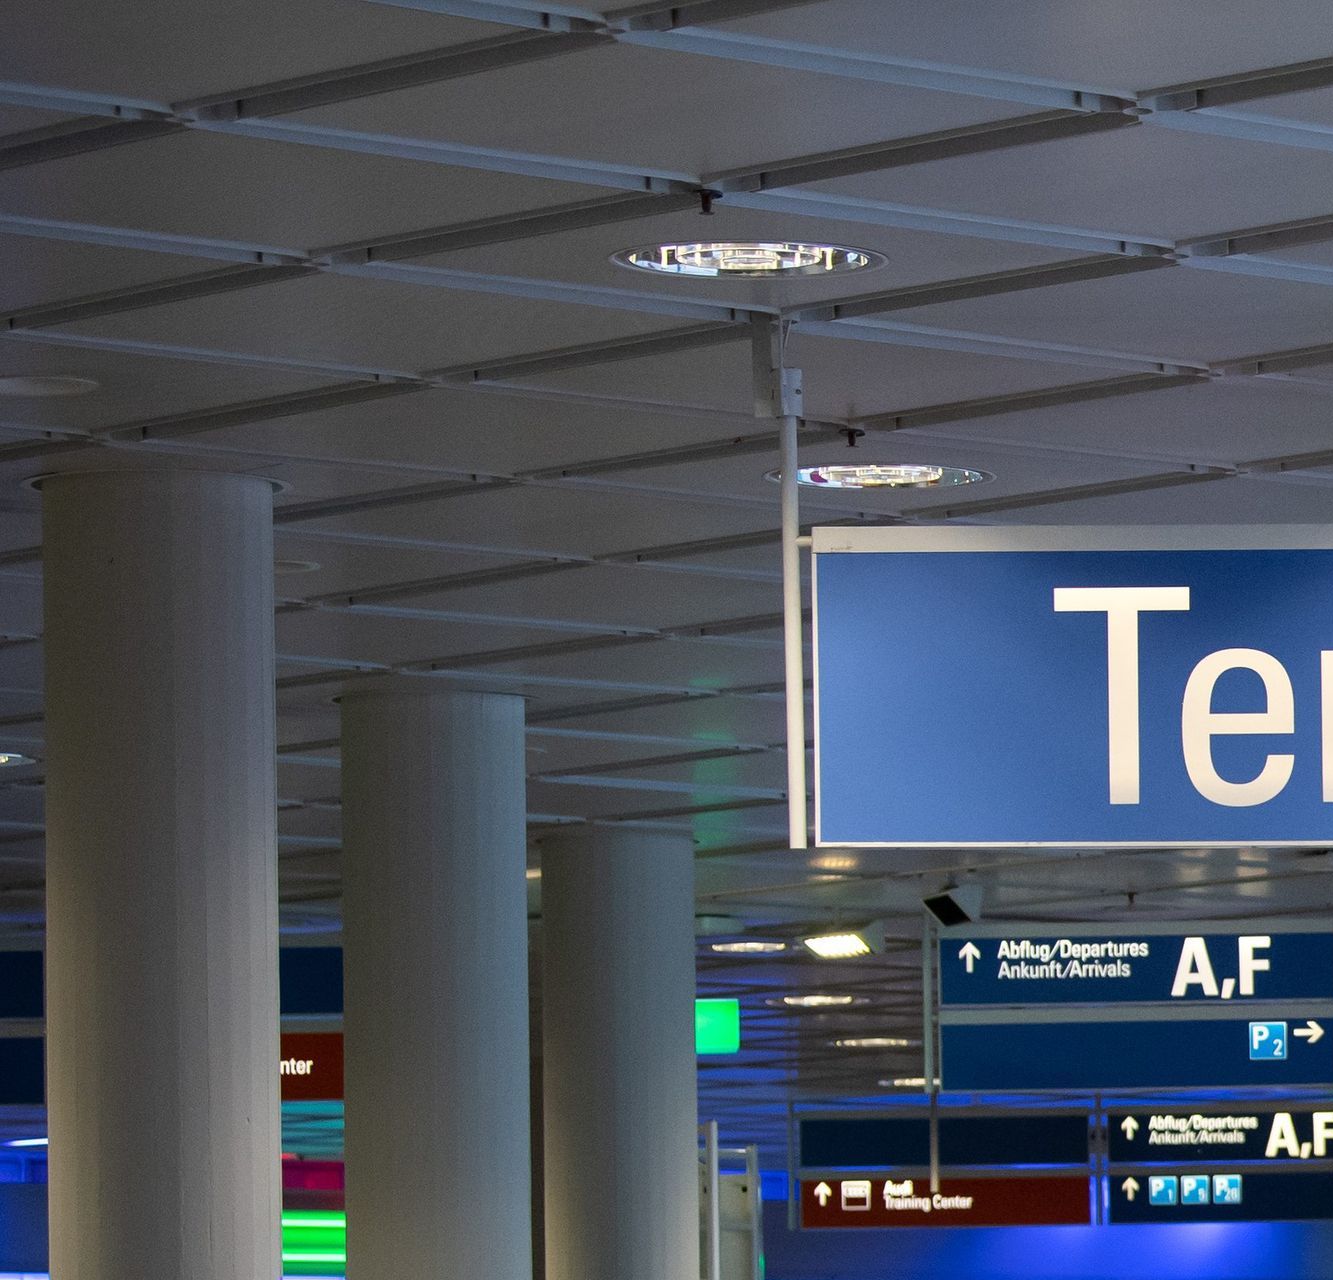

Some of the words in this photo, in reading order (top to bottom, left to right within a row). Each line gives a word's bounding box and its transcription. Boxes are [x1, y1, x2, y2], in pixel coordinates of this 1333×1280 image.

[997, 939, 1149, 960] Abflug/Departures
[997, 959, 1131, 979] Ankunft/Arrivals
[1148, 1114, 1259, 1131] Abflug/Departures
[1148, 1129, 1246, 1145] Ankunft/Arrivals
[932, 1193, 973, 1210] Center
